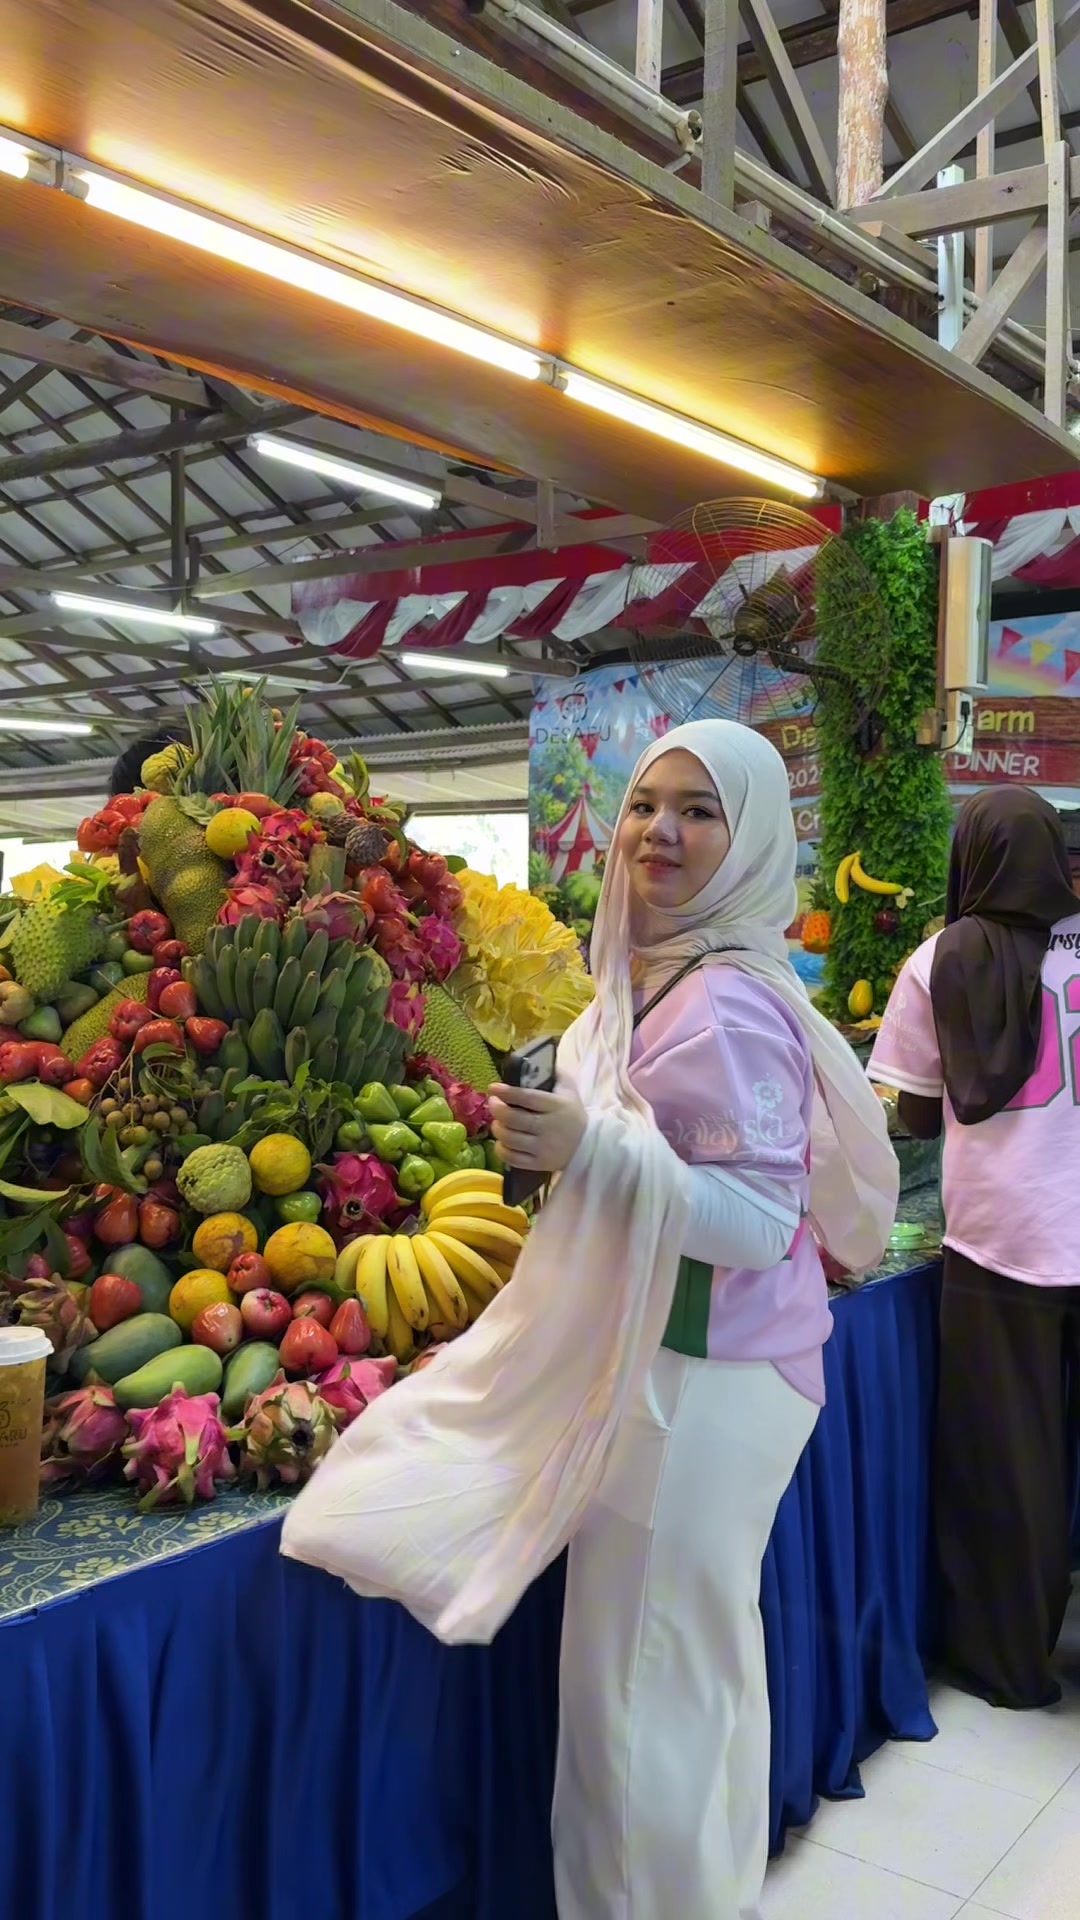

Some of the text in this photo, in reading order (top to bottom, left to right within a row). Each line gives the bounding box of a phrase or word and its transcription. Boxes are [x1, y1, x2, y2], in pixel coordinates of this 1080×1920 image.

[976, 708, 1035, 733] arm
[535, 724, 611, 744] DESARU
[953, 750, 1040, 776] DINNER
[788, 764, 824, 790] 202
